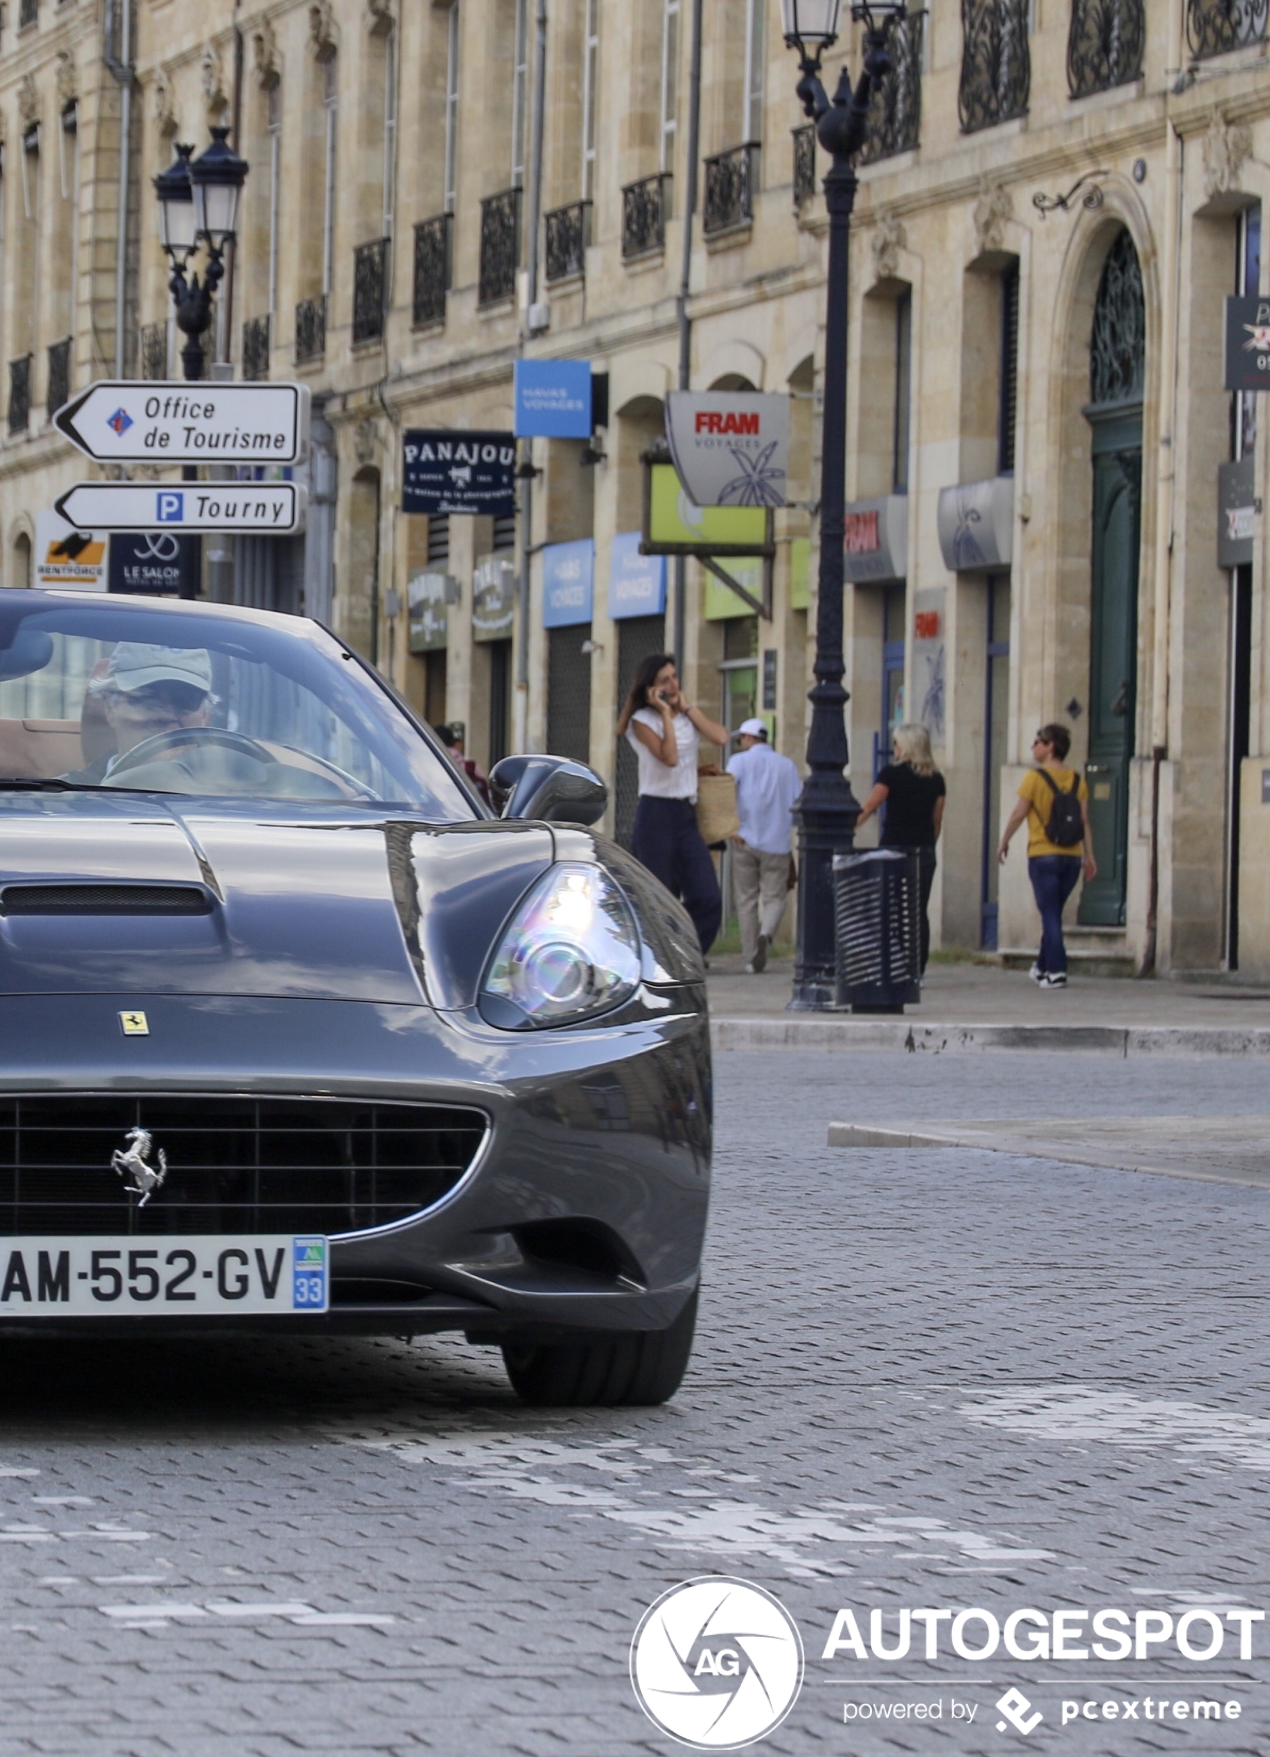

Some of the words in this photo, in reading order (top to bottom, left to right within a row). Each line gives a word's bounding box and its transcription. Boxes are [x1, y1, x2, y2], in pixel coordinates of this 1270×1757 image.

[145, 397, 216, 419] Office
[694, 412, 760, 435] FRAM
[144, 427, 170, 448] de
[183, 427, 286, 449] Tourisme
[694, 438, 761, 449] VOYAGES
[404, 442, 515, 465] PANAJOU
[160, 495, 180, 520] P
[196, 497, 284, 522] Tourny
[124, 566, 139, 577] LE
[0, 1247, 286, 1303] AM-552-GV
[295, 1277, 323, 1303] 33
